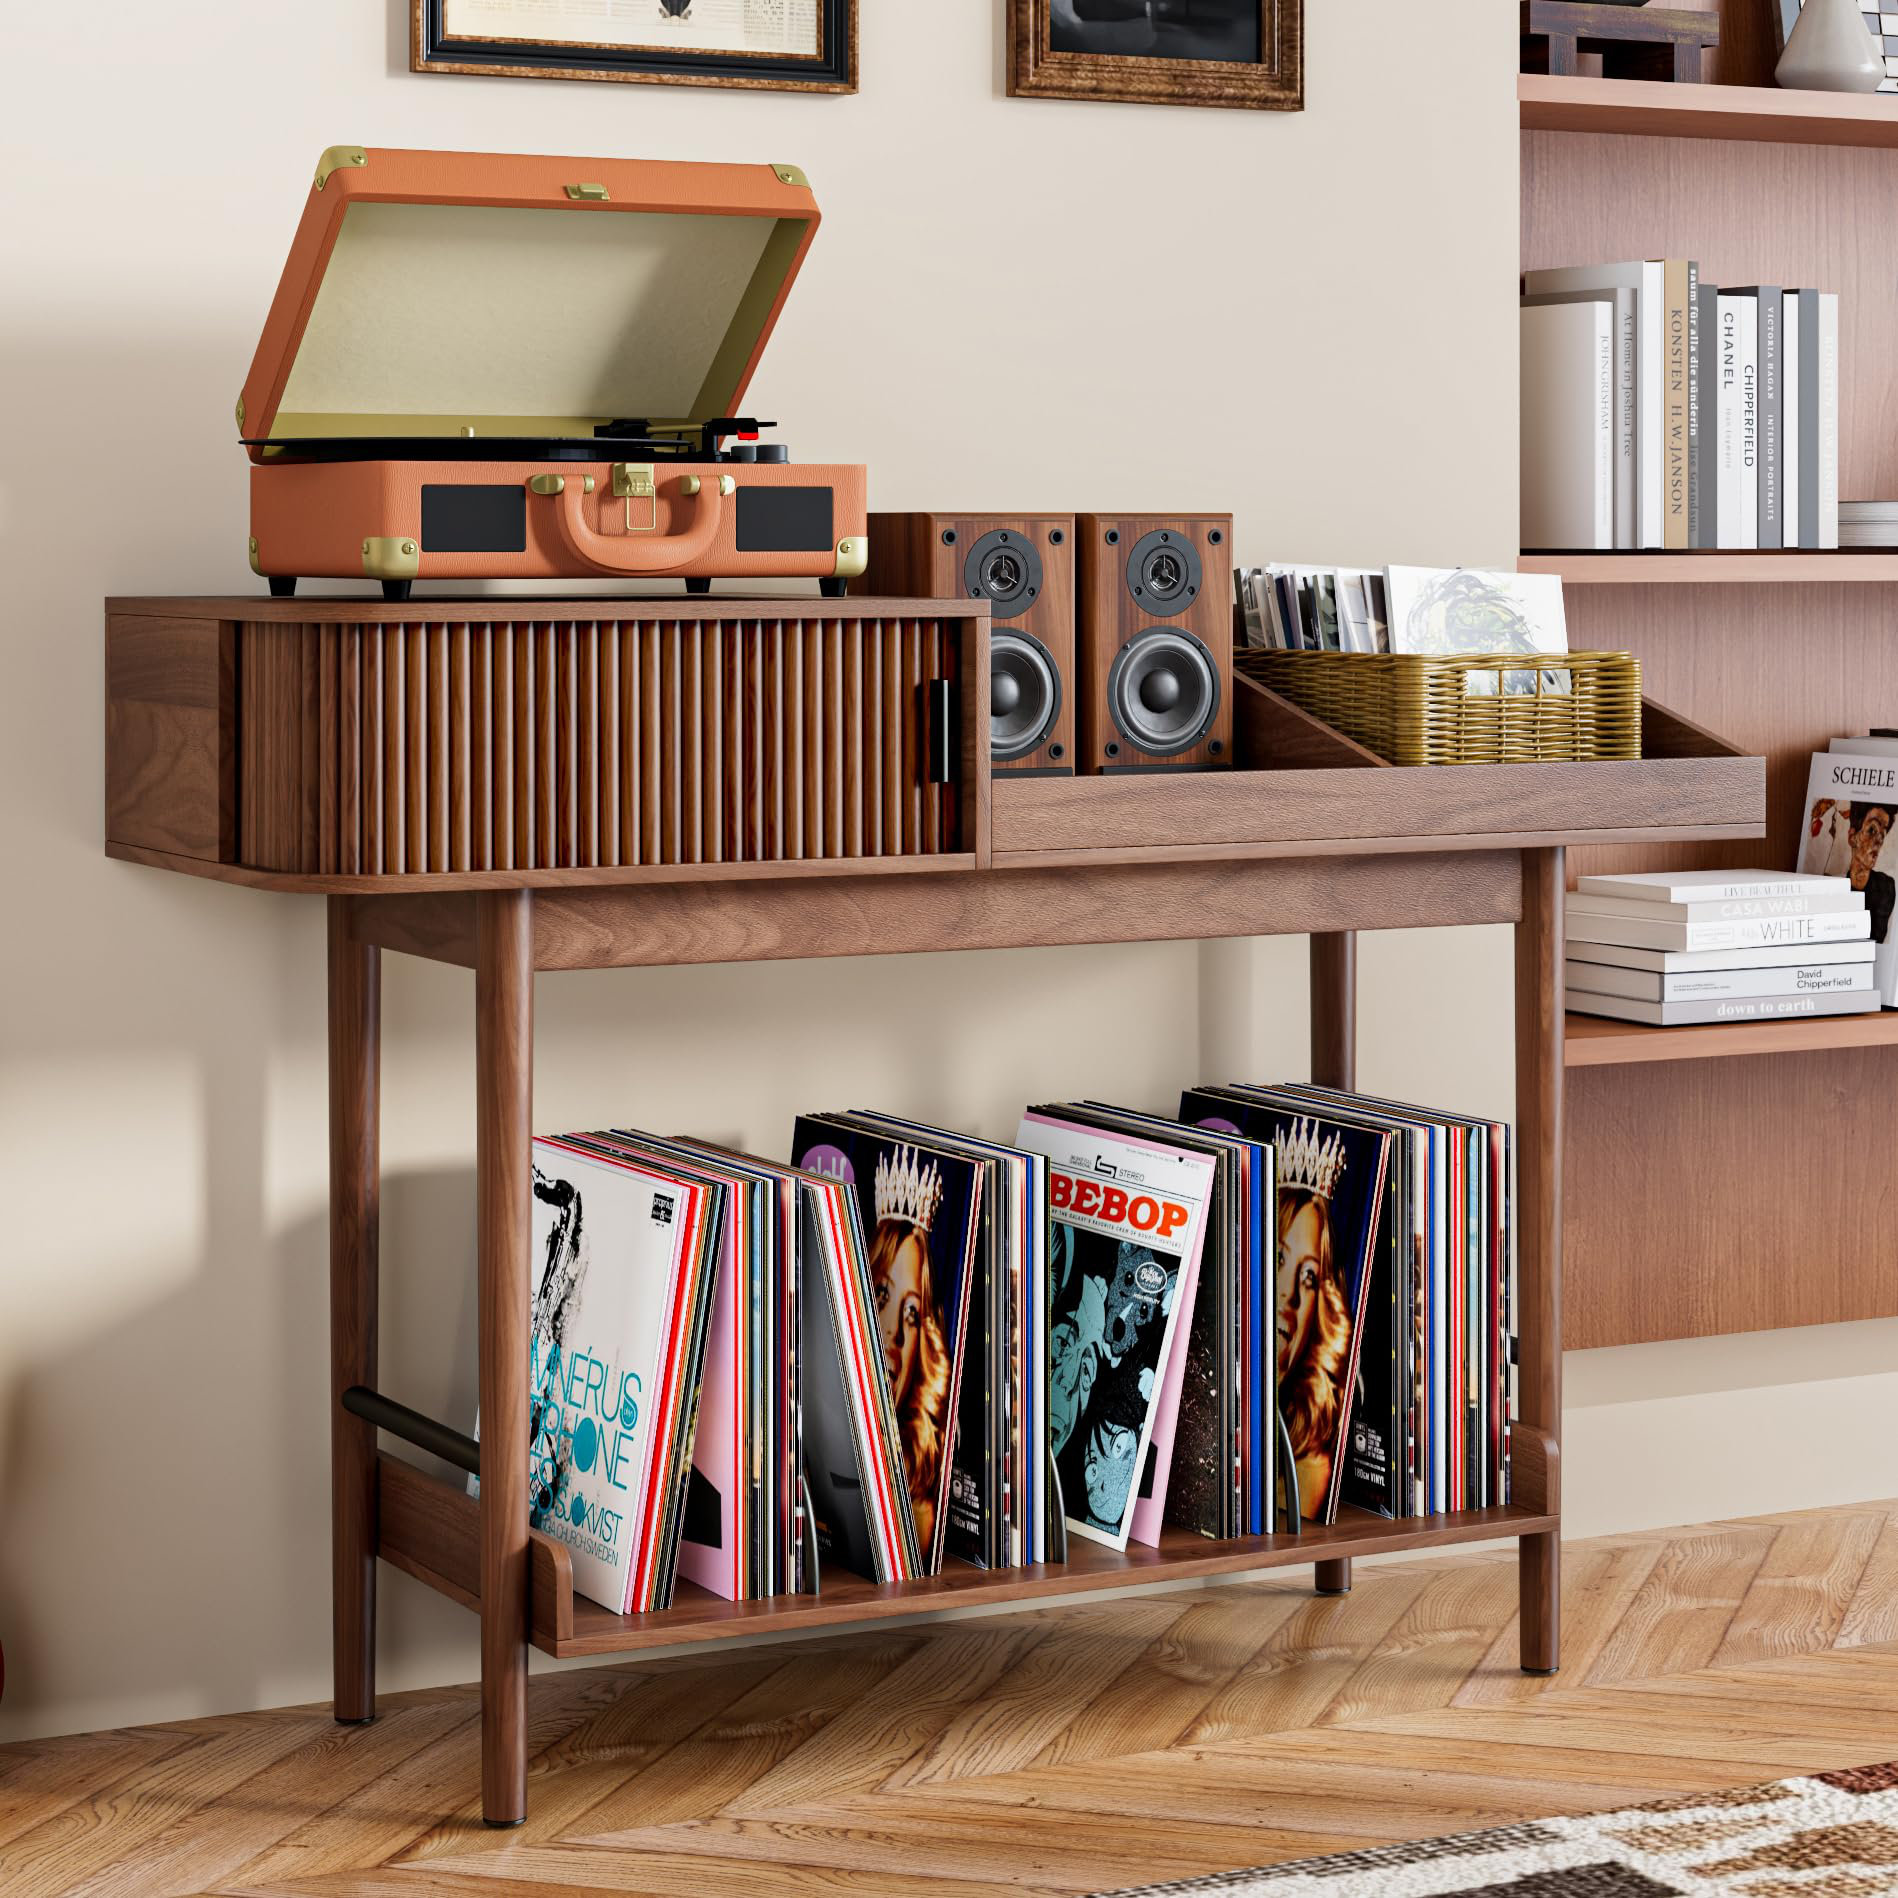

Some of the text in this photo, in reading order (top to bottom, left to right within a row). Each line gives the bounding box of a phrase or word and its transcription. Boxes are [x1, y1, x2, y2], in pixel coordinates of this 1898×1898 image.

[1690, 306, 1698, 326] für
[1671, 309, 1682, 391] KONSTEN
[1690, 329, 1698, 352] alla
[1724, 312, 1734, 390] CHANEL
[1690, 356, 1698, 376] die
[1621, 312, 1632, 457] At Home in Joshua Tree
[1690, 380, 1698, 436] sünderin
[1744, 364, 1754, 467] CHIPPERFIELD
[1832, 766, 1896, 788] SCHIELE
[1724, 886, 1745, 897] LIVE
[1720, 897, 1809, 917] CASA WABI
[1760, 919, 1816, 940] WHITE
[1796, 970, 1822, 979] David
[1796, 978, 1852, 990] Chipperfield
[1717, 998, 1815, 1016] down to earth
[1119, 1168, 1144, 1182] STEREO
[1050, 1172, 1188, 1238] BEBOP
[1370, 1472, 1386, 1487] VINYL
[555, 1487, 624, 1546] SJÖKVIST
[966, 1520, 980, 1536] VINYL
[556, 1522, 587, 1550] CHURCH
[586, 1538, 619, 1567] SWEDEN
